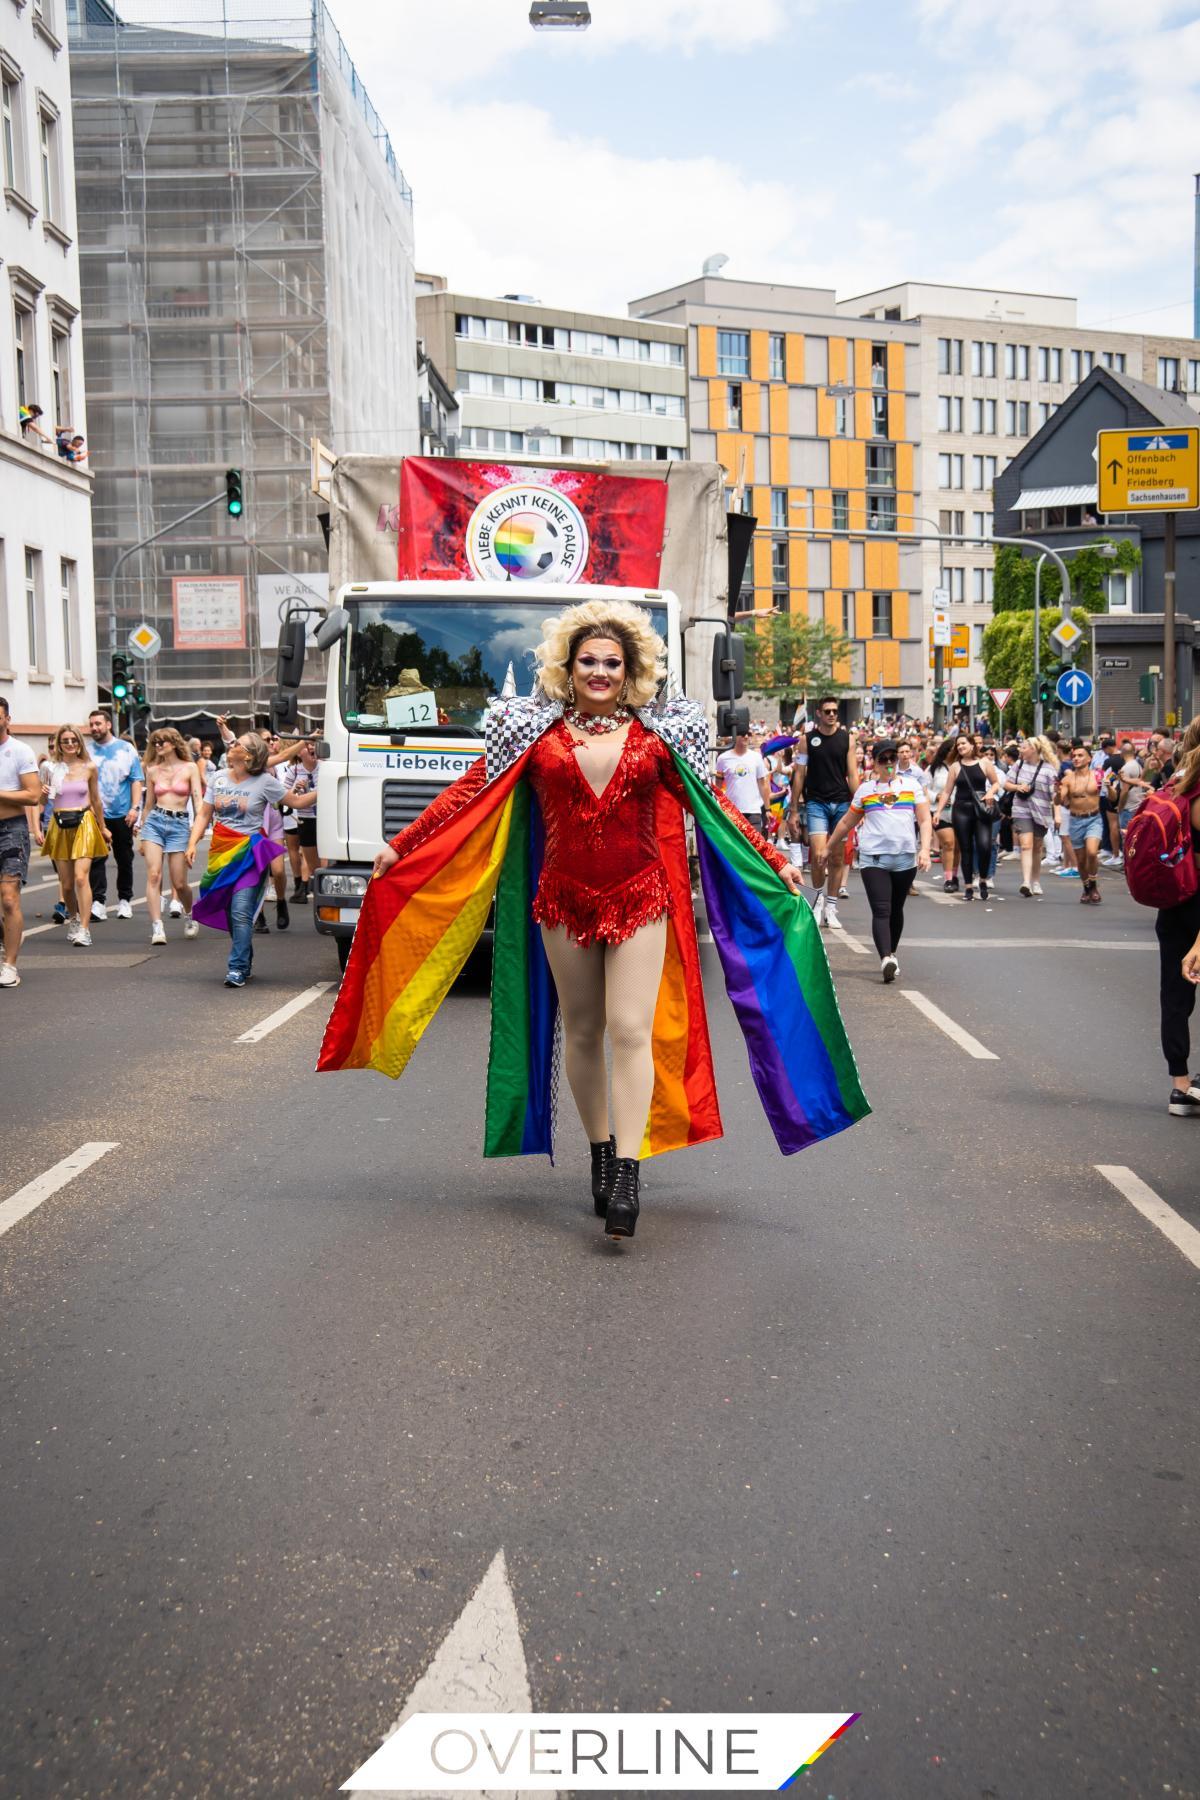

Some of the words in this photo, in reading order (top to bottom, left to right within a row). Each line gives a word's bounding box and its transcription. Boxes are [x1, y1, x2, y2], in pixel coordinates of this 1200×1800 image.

[1127, 453, 1176, 463] Offenbach
[1127, 467, 1157, 475] Hanau
[1127, 478, 1174, 487] Friedberg
[1130, 493, 1186, 502] Sachsenhausen
[478, 522, 492, 561] LIEBE
[486, 495, 528, 523] KENNT
[532, 495, 568, 524] KEINE
[560, 524, 576, 569] PAUSE
[273, 585, 291, 595] WE
[294, 584, 314, 594] ARE
[408, 704, 431, 723] 12
[216, 788, 232, 796] PEW
